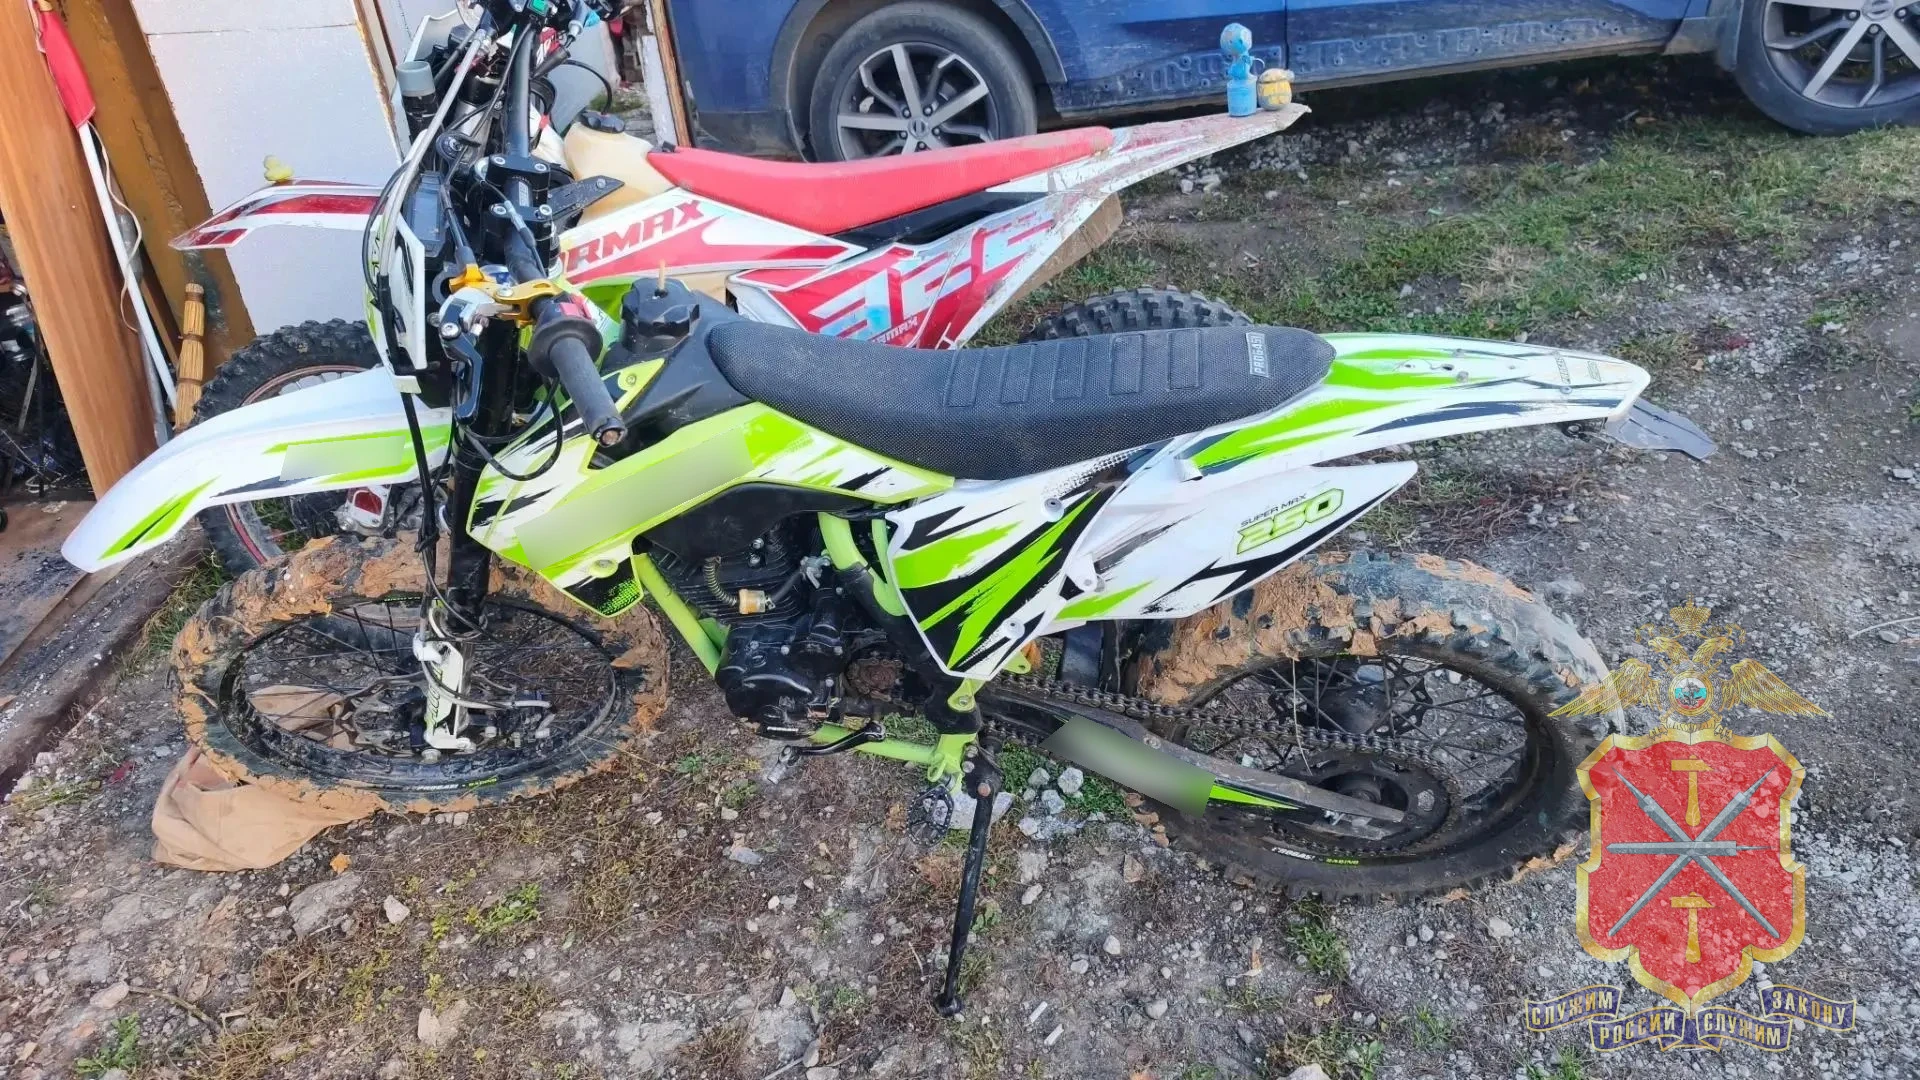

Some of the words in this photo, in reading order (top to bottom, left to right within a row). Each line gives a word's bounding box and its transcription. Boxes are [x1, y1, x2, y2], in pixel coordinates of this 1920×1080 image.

[560, 200, 704, 271] RMAX
[1237, 488, 1344, 555] 250
[1241, 508, 1279, 527] SUPER
[1281, 493, 1307, 512] MAX
